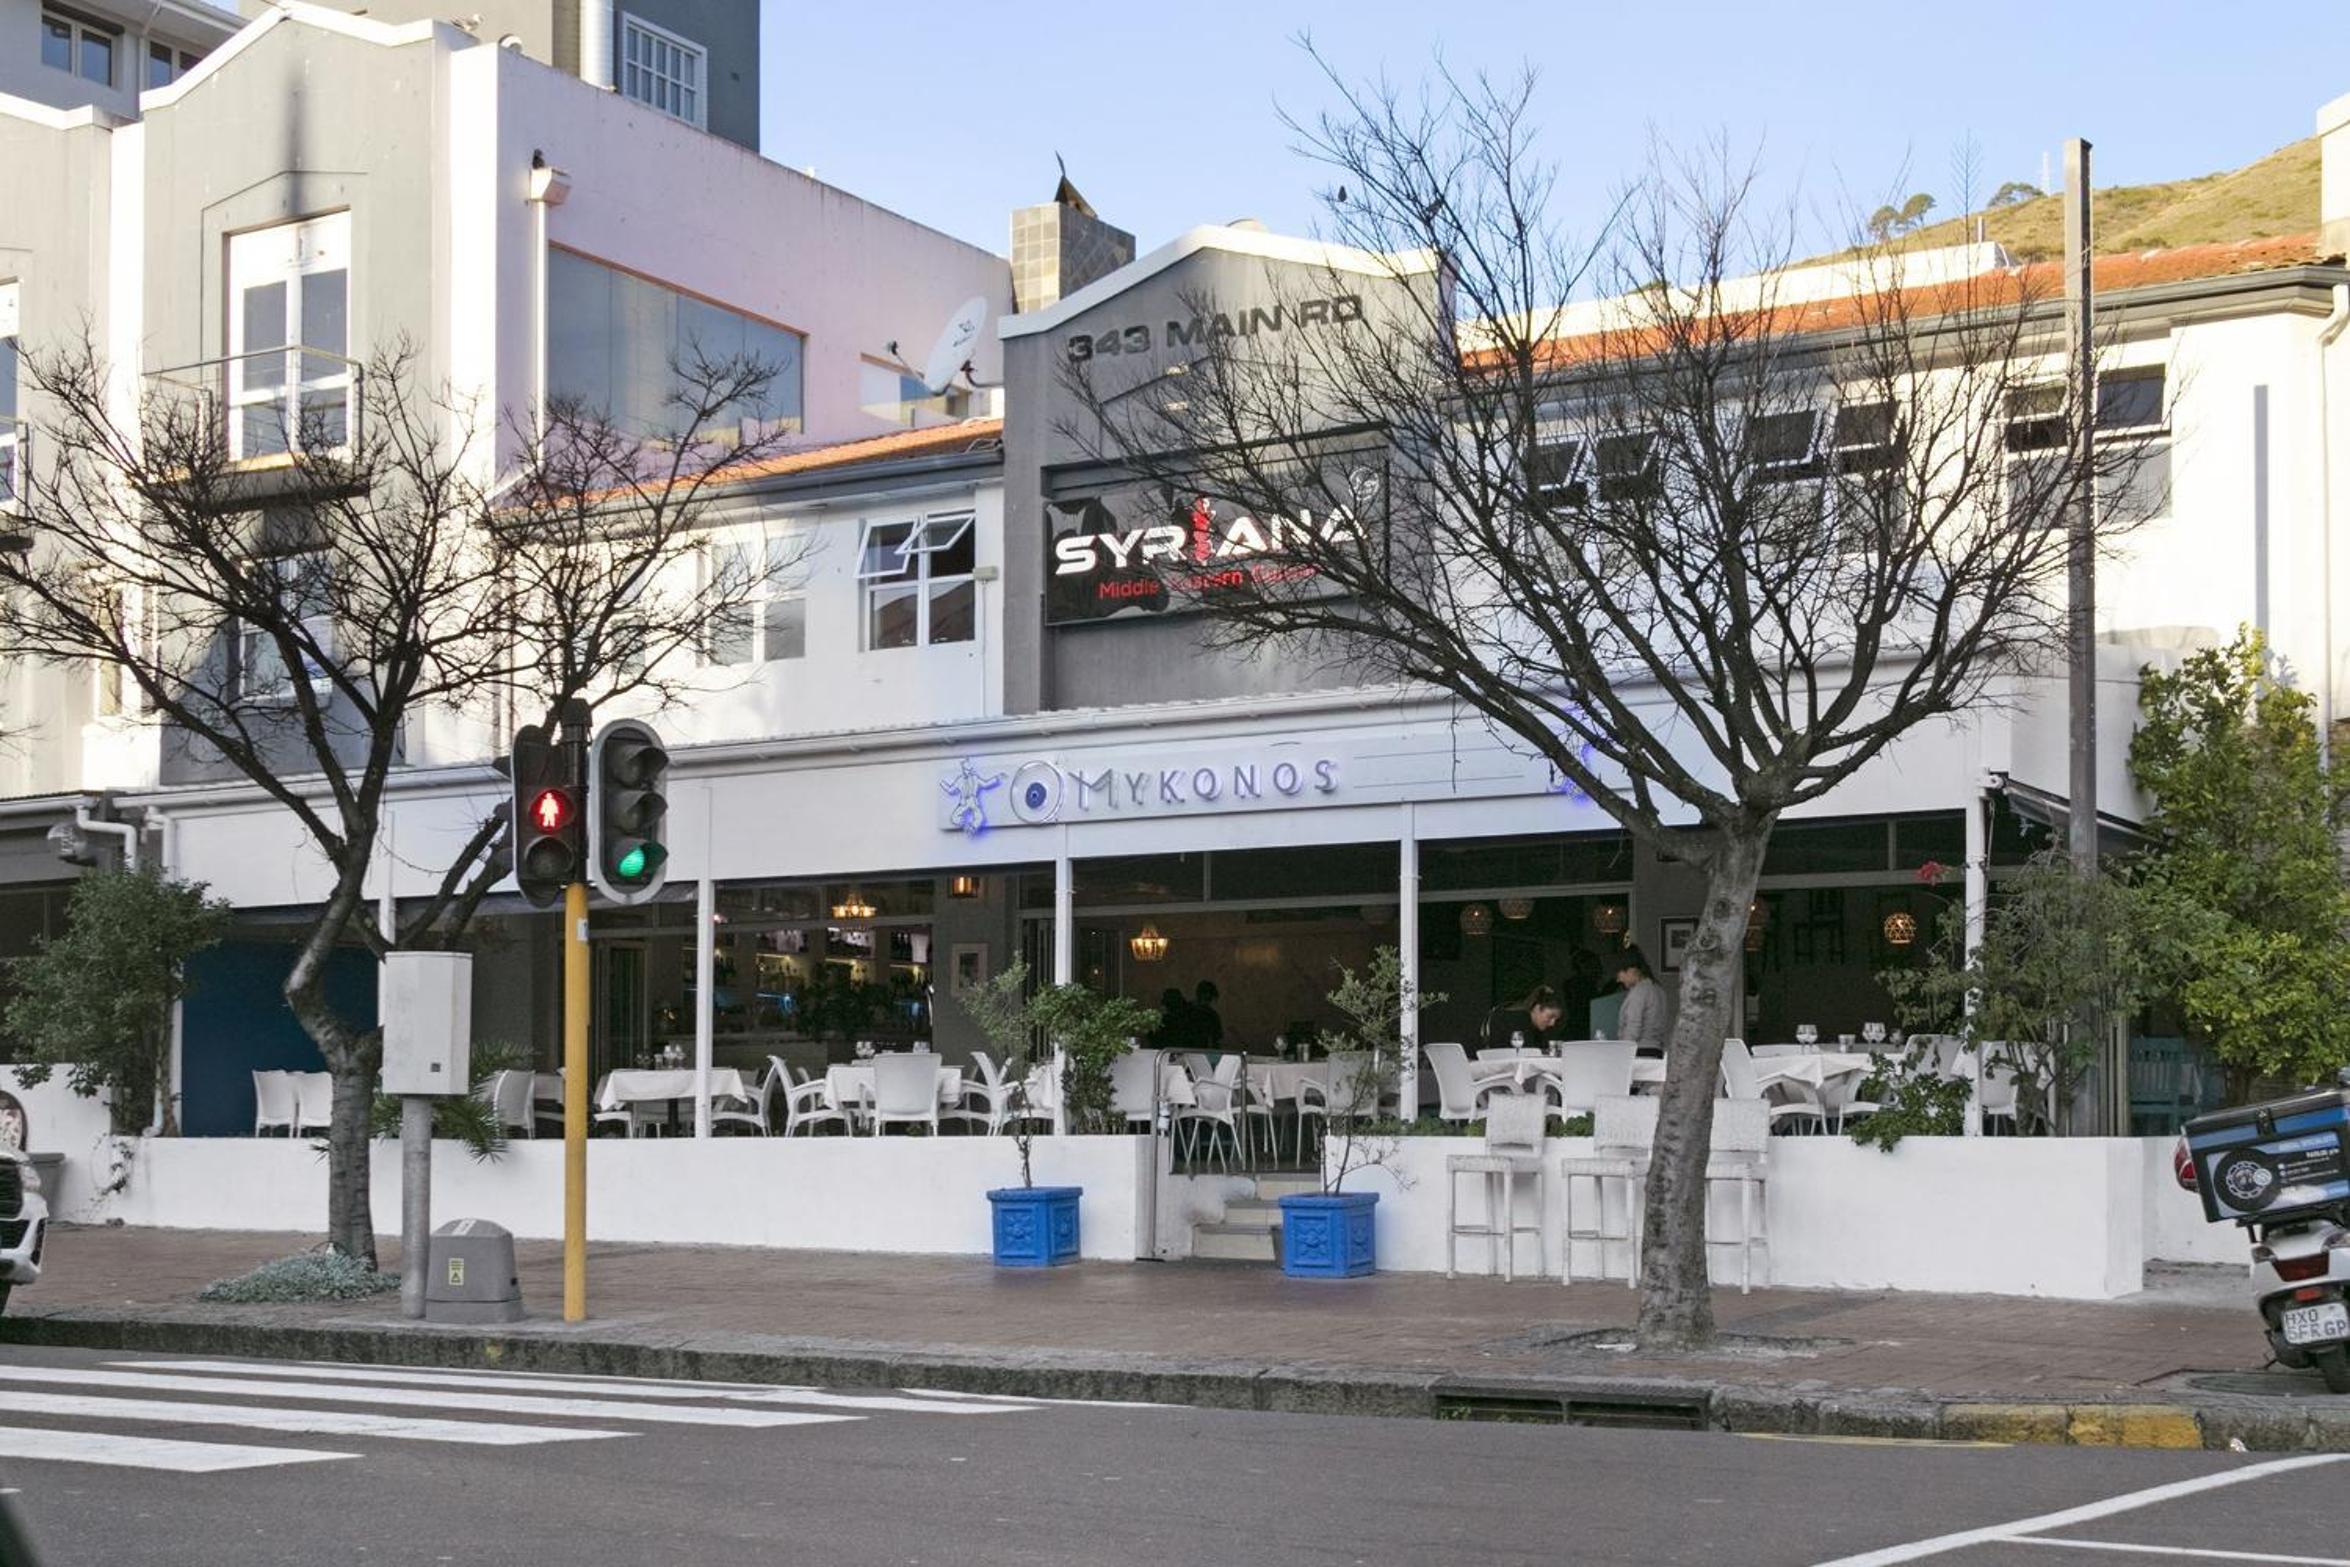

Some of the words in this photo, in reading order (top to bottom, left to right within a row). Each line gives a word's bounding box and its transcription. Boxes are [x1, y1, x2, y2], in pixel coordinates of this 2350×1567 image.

[1067, 325, 1150, 361] 343
[1166, 305, 1282, 348] MAIN
[1300, 297, 1363, 328] RD
[1055, 498, 1368, 575] SYRIANA
[1098, 578, 1159, 600] Middle
[1068, 759, 1338, 811] MYKONOS
[2324, 1319, 2347, 1337] GP
